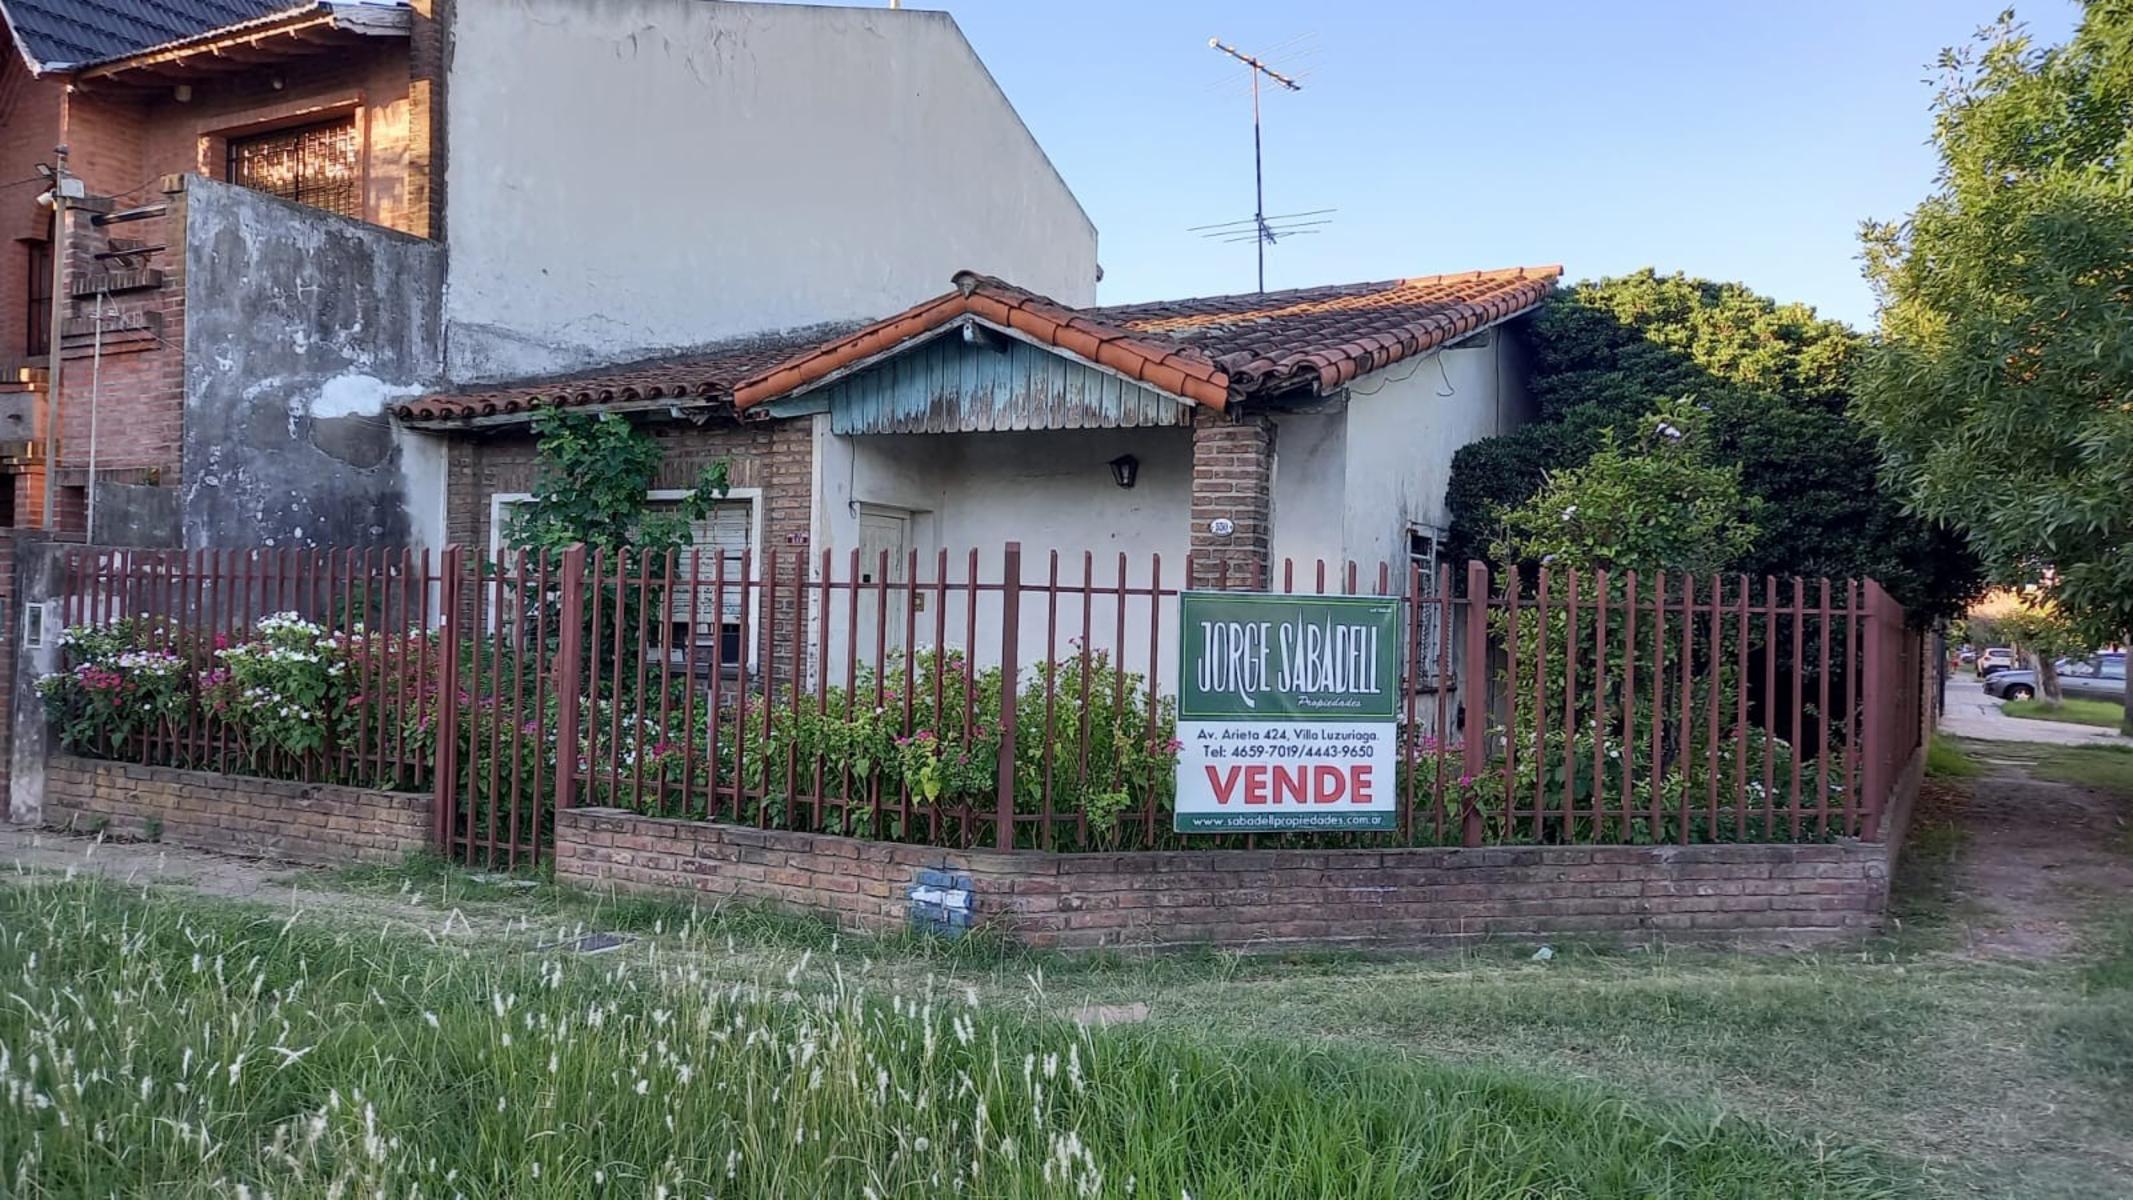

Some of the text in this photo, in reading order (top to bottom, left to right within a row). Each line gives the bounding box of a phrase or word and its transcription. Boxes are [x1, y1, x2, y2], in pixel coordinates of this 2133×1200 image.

[1198, 607, 1381, 708] JORGE SABADELL
[1297, 695, 1362, 708] Propiedades
[1197, 729, 1380, 743] Av. Arieta 424, Villa Luzuriaga.
[1204, 745, 1373, 758] Tel: 4659-7019/4443-9650
[1205, 765, 1372, 805] VENDE
[1193, 813, 1382, 827] www.sabadellpropiedades.com.ar
